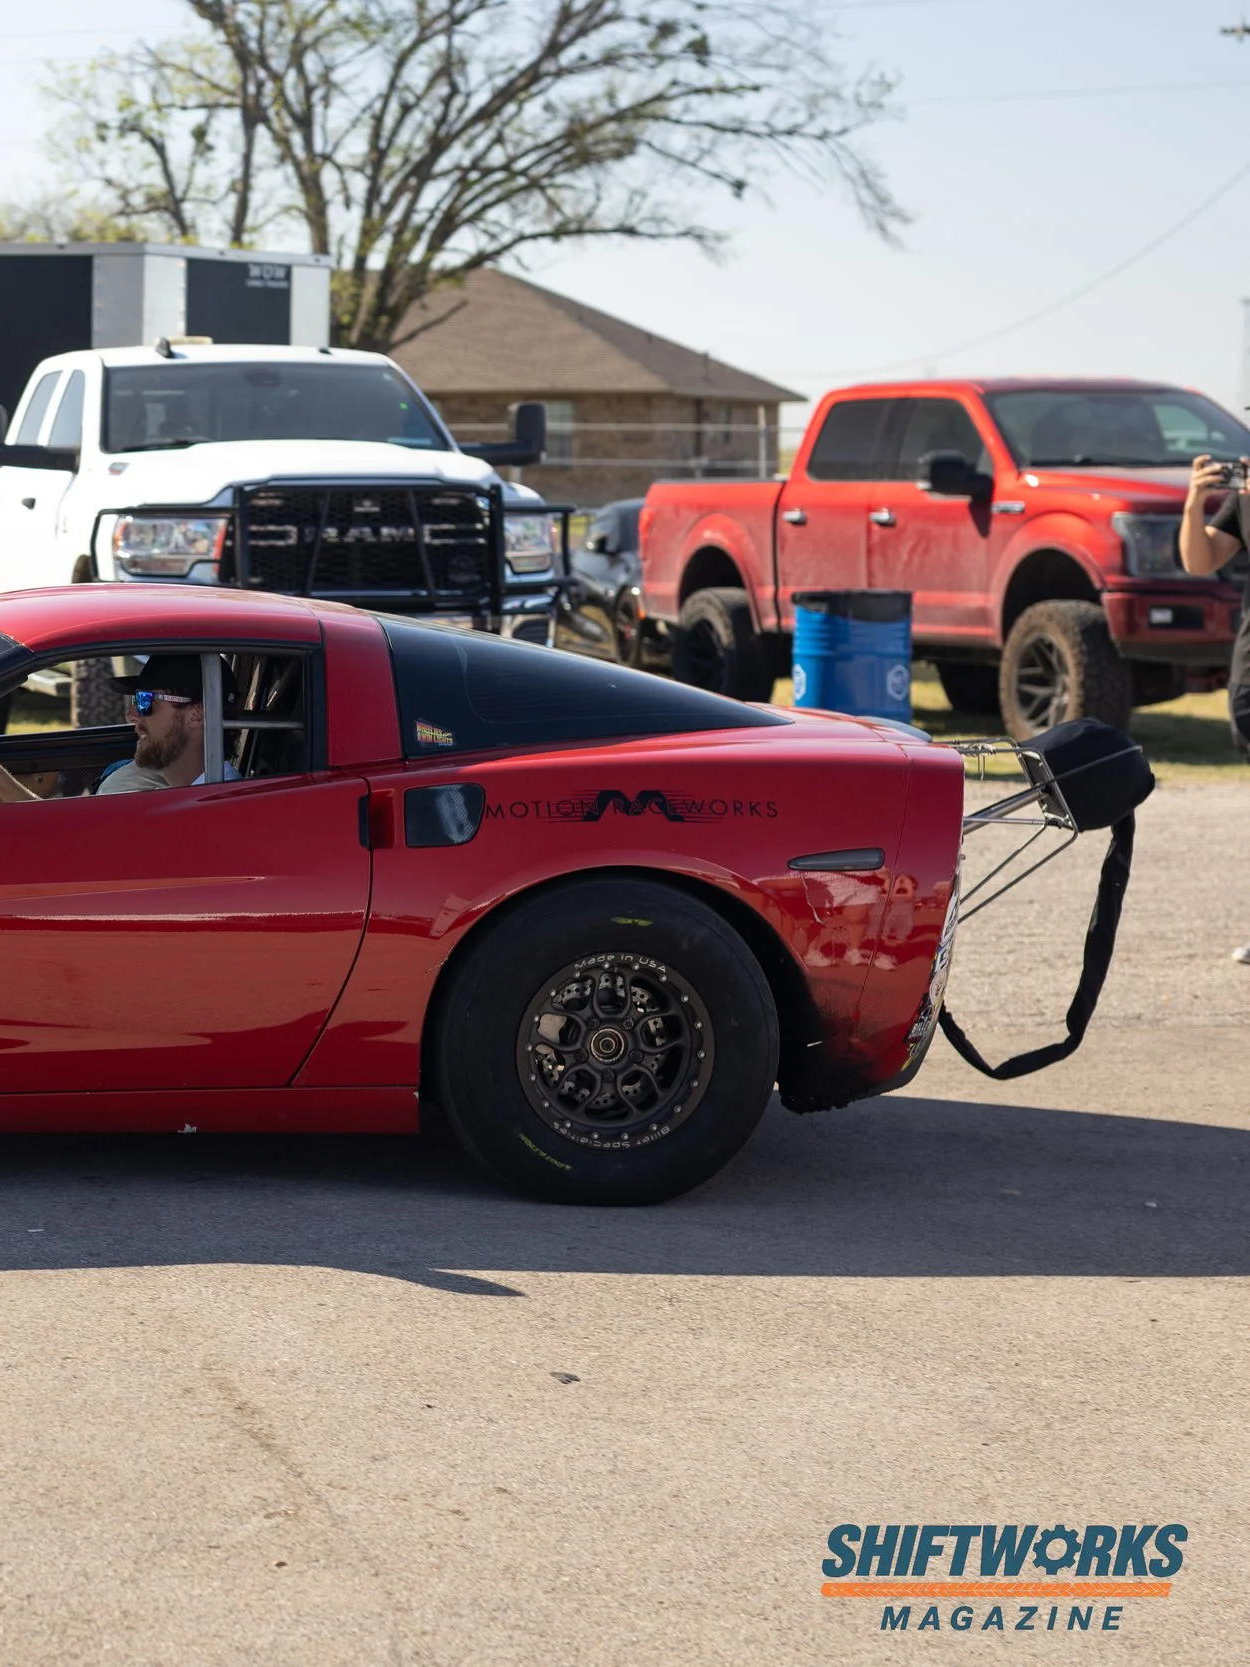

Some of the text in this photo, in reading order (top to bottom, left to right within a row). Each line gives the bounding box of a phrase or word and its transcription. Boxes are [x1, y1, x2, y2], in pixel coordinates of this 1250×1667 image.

[304, 526, 417, 542] RAM
[485, 799, 778, 820] MOTION RACEWORKS
[574, 954, 667, 974] Made in USA
